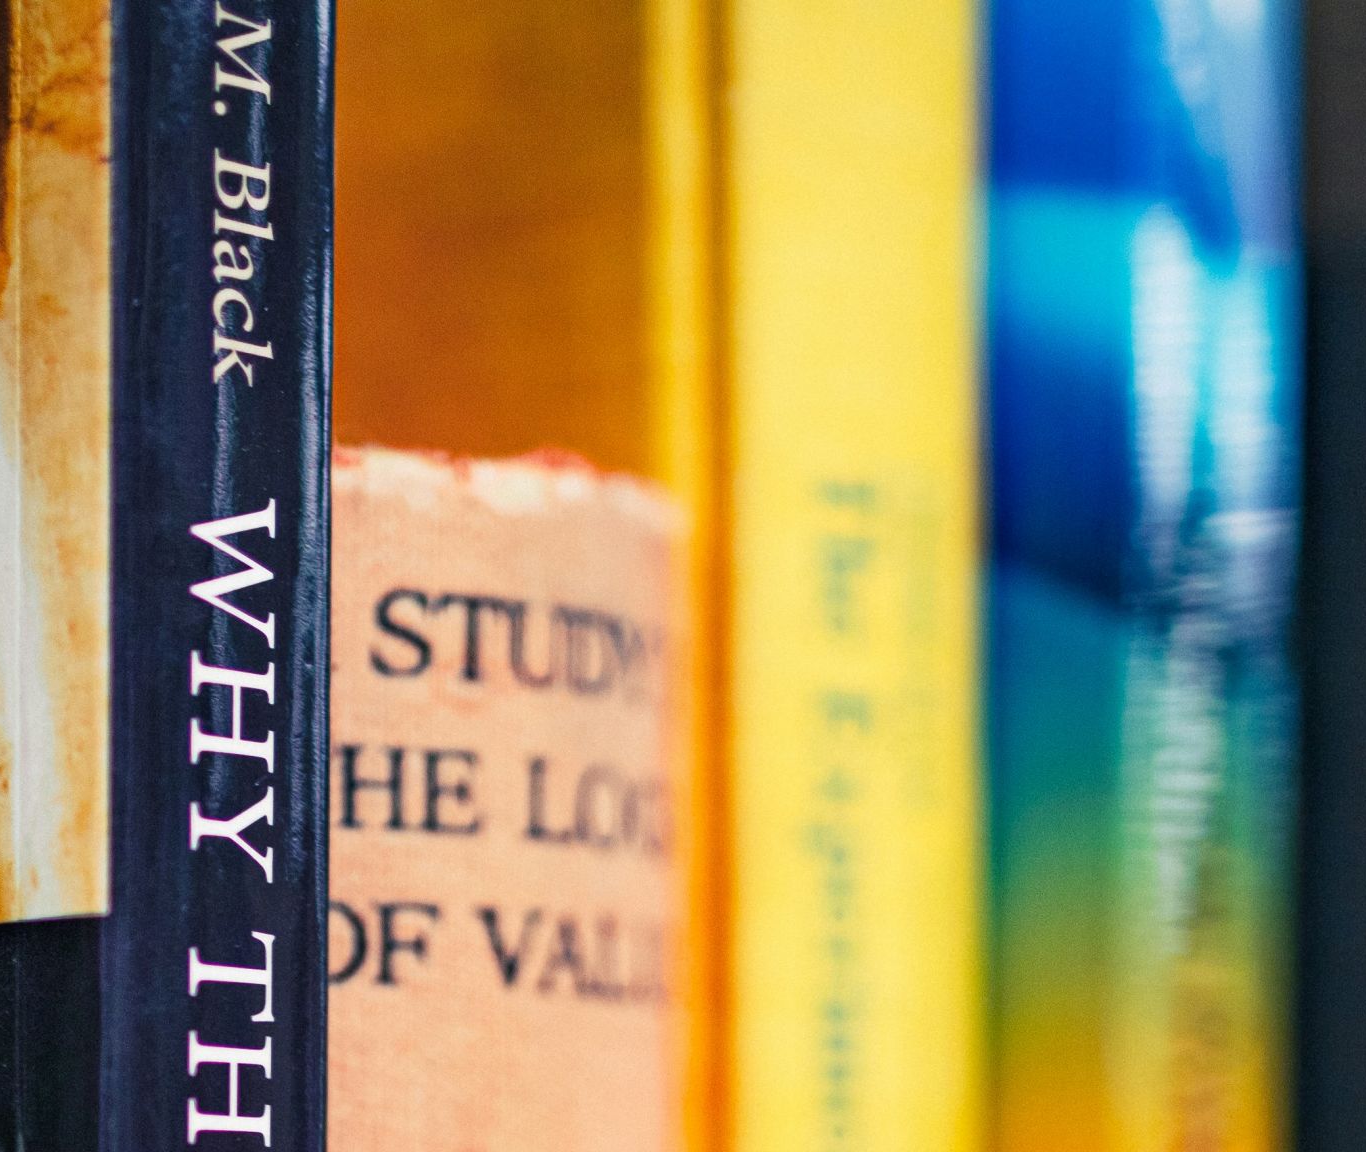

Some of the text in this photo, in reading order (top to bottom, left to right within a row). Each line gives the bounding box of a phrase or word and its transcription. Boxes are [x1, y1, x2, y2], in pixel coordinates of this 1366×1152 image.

[212, 0, 274, 387] M. Black
[189, 498, 276, 884] WHY
[329, 743, 482, 836] HE
